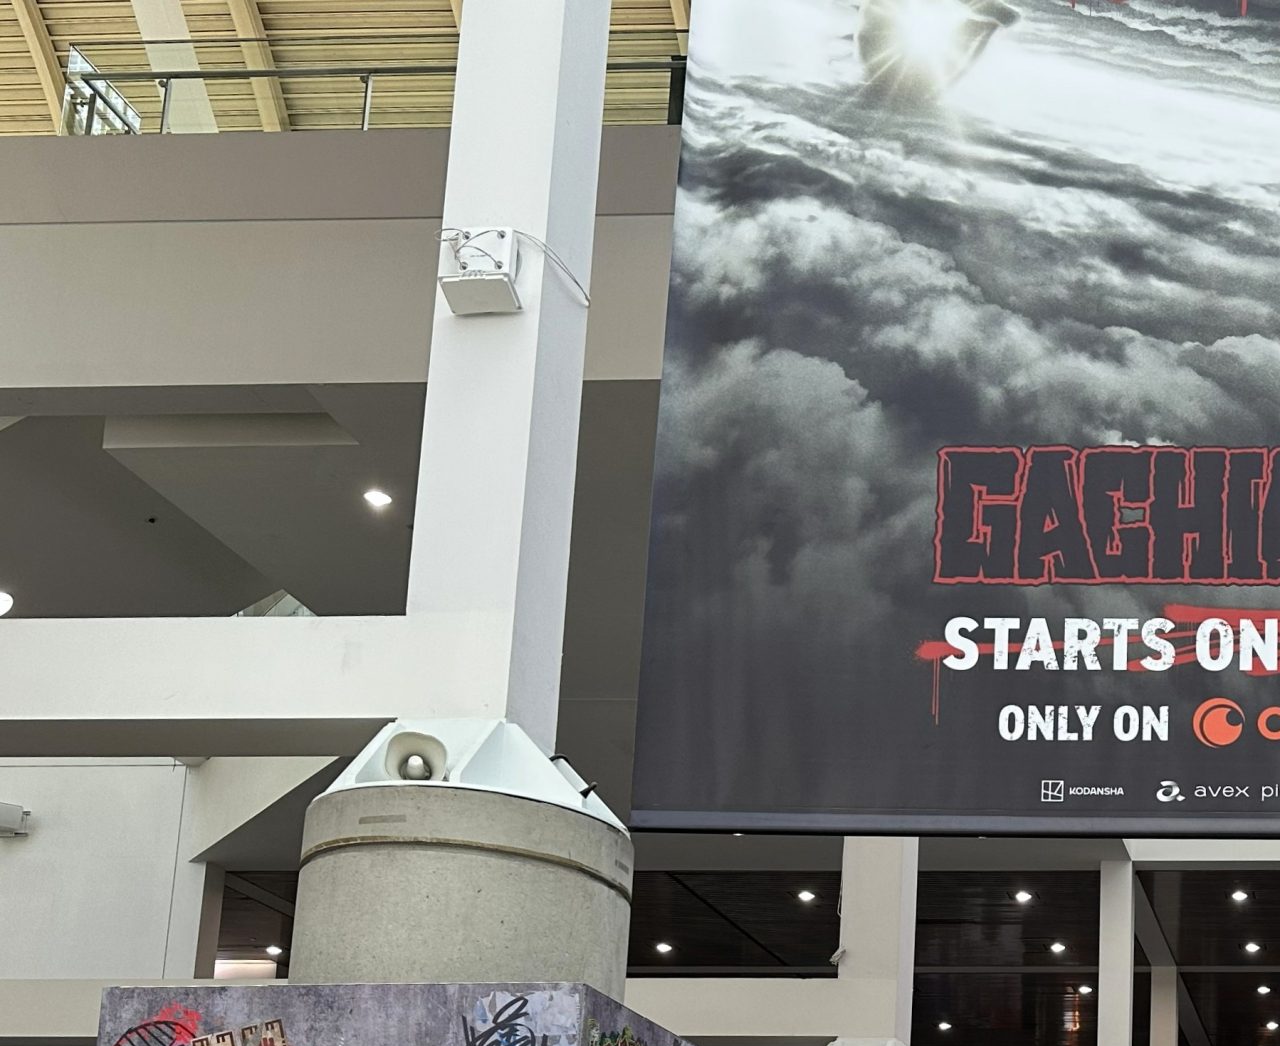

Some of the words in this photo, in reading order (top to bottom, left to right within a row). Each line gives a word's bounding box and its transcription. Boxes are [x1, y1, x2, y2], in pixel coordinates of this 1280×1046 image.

[942, 616, 1176, 672] STARTS
[1195, 617, 1279, 672] ON
[998, 704, 1101, 742] ONLY
[1113, 704, 1169, 742] ON
[1068, 786, 1125, 798] KODANSHA
[1194, 784, 1250, 798] avex
